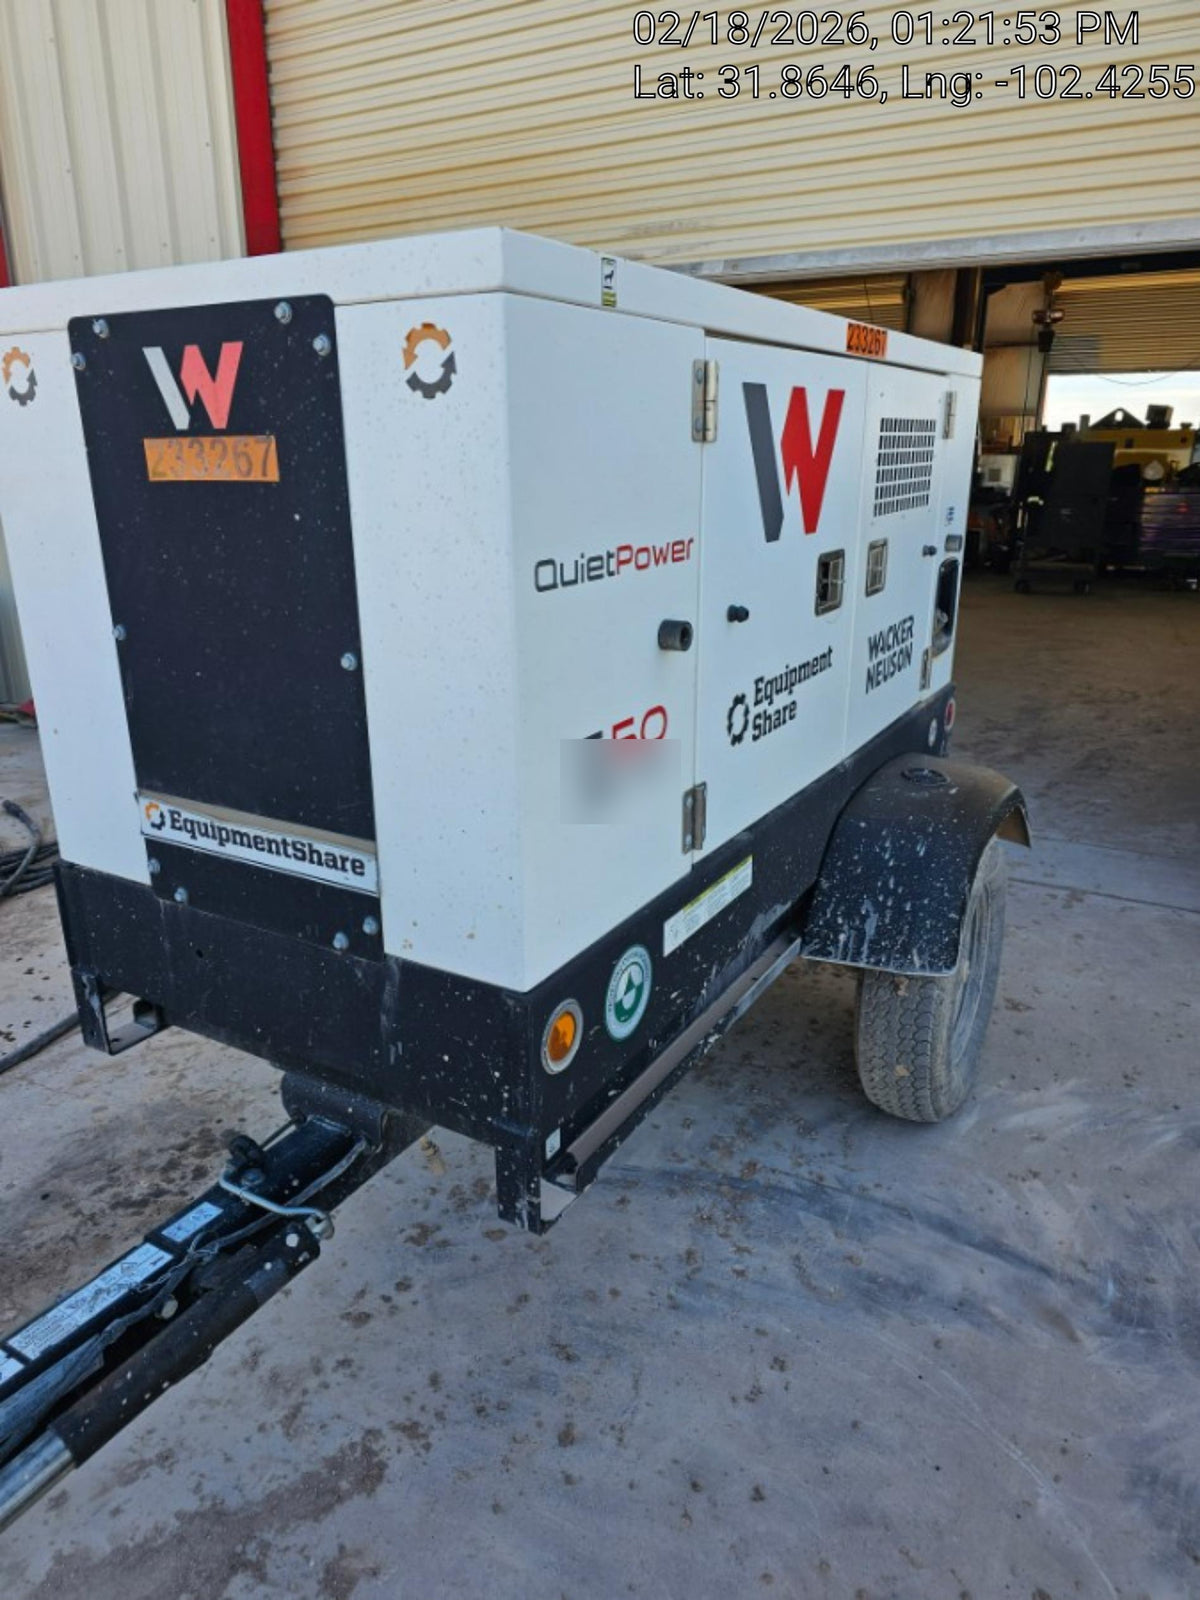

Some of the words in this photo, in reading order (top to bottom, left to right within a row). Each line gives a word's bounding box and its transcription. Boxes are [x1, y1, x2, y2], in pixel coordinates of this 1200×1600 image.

[846, 321, 887, 356] 233267
[148, 435, 274, 478] 233267
[534, 537, 695, 593] QuietPower
[867, 615, 914, 662] WACKER
[753, 645, 833, 707] Equipment
[865, 641, 912, 695] NEUSON
[751, 700, 797, 742] Share
[168, 808, 366, 877] EquipmentShare
